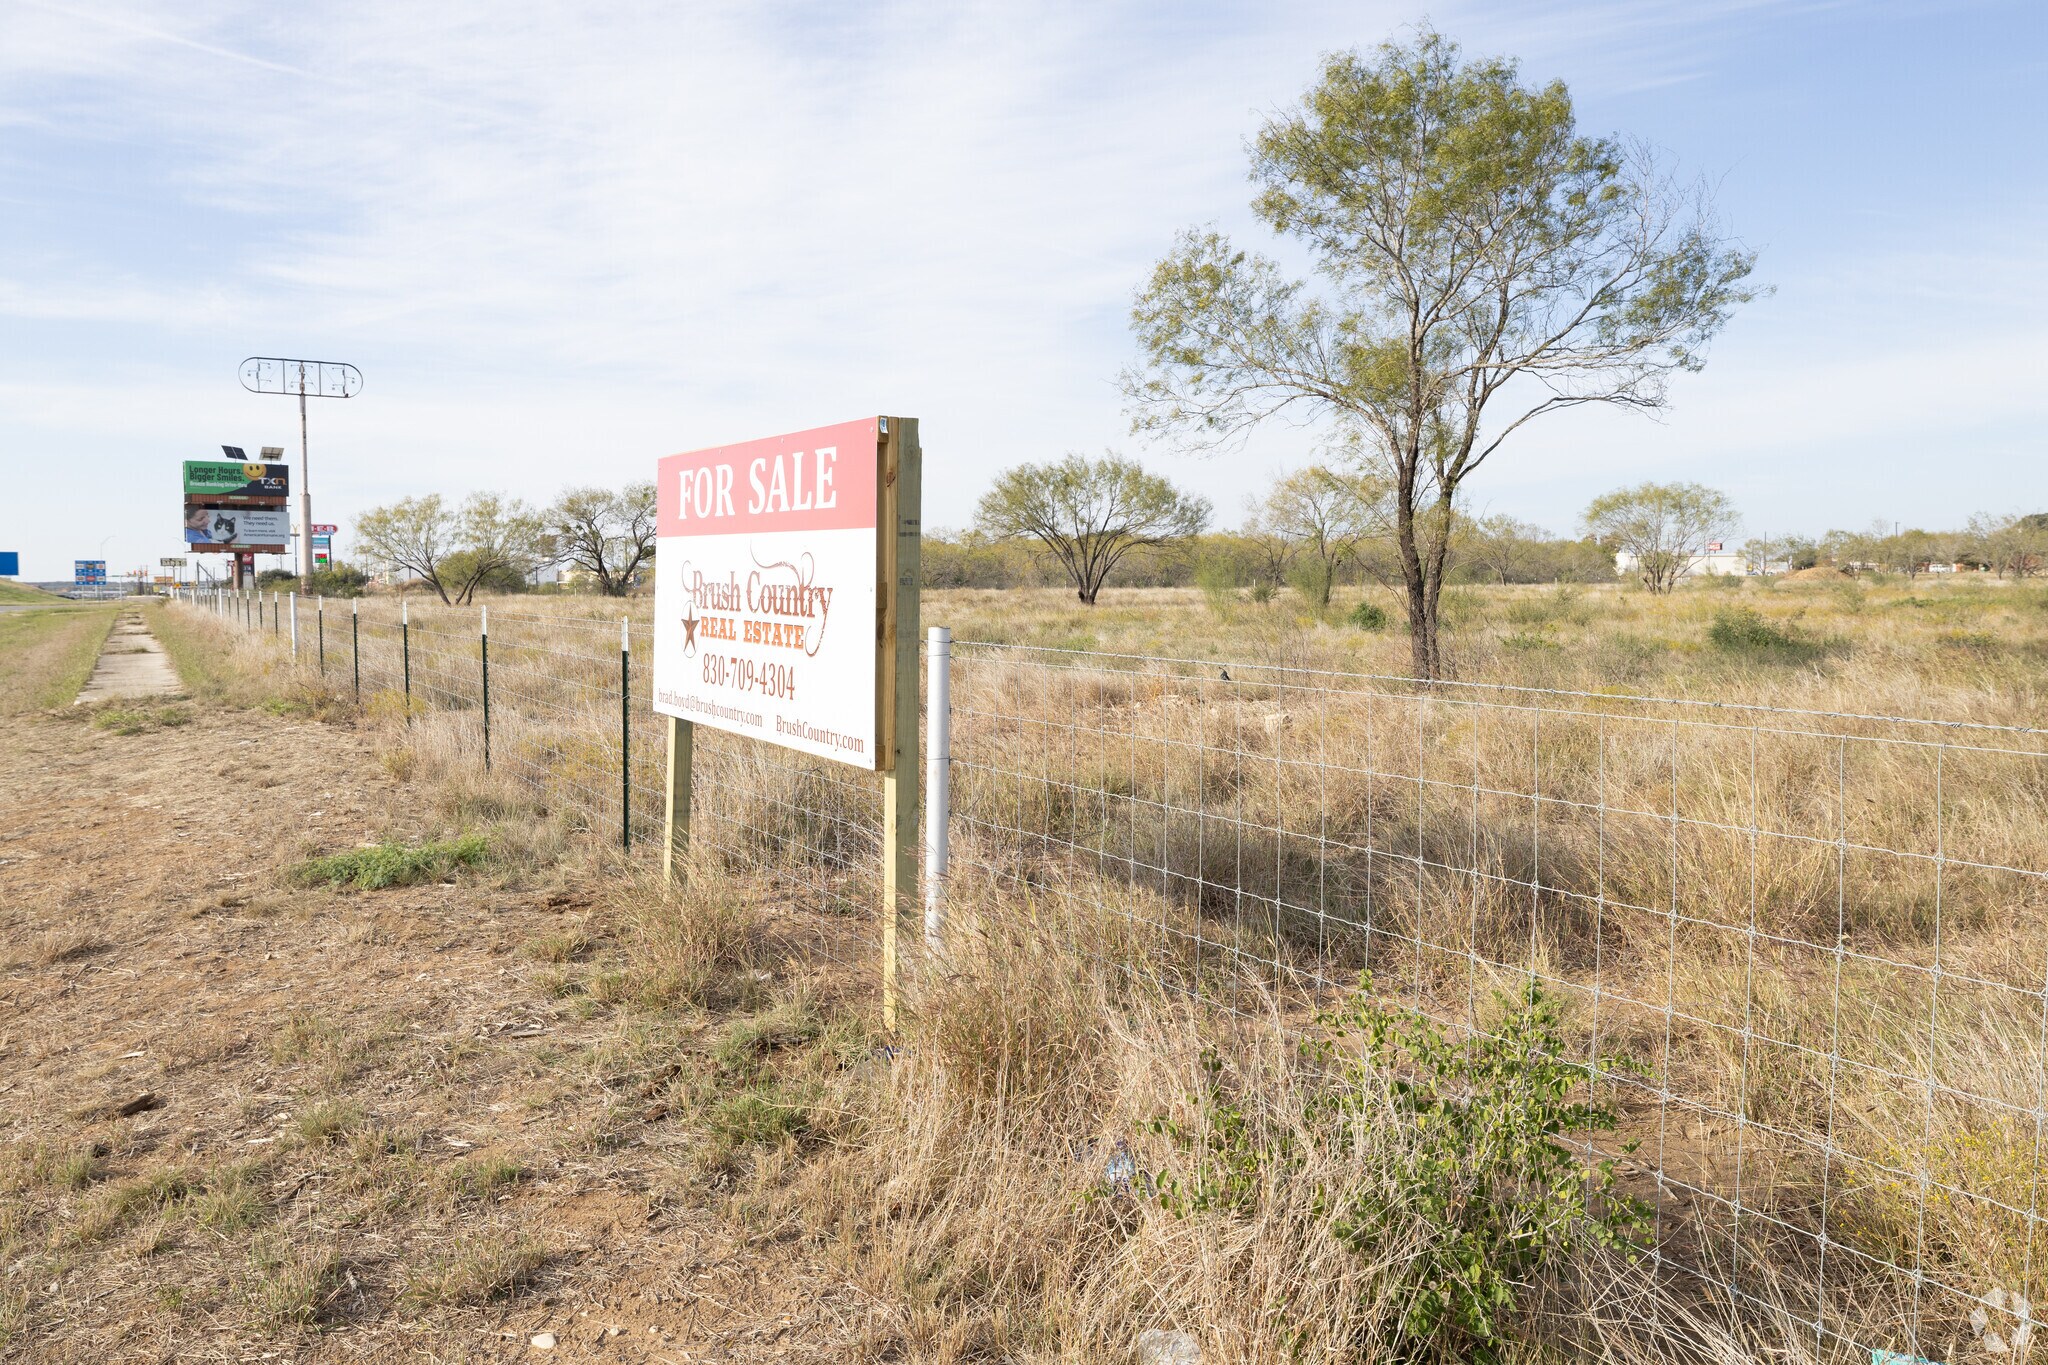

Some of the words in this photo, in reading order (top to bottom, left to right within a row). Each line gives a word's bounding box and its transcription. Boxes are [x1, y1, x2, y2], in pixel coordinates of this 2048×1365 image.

[189, 465, 216, 476] Longer
[218, 466, 244, 475] Hours.
[189, 472, 215, 482] Bigger
[216, 473, 245, 482] Smiles.
[678, 463, 735, 520] FOR
[748, 446, 837, 515] SALE
[682, 562, 741, 612] Brush
[746, 568, 834, 657] Country
[700, 616, 736, 641] REAL
[743, 620, 804, 650] ESTATE
[702, 653, 795, 700] 830-709-4304
[658, 688, 763, 728] brad.boyd@brushcountry.com
[776, 714, 864, 753] BrushCountry.com
